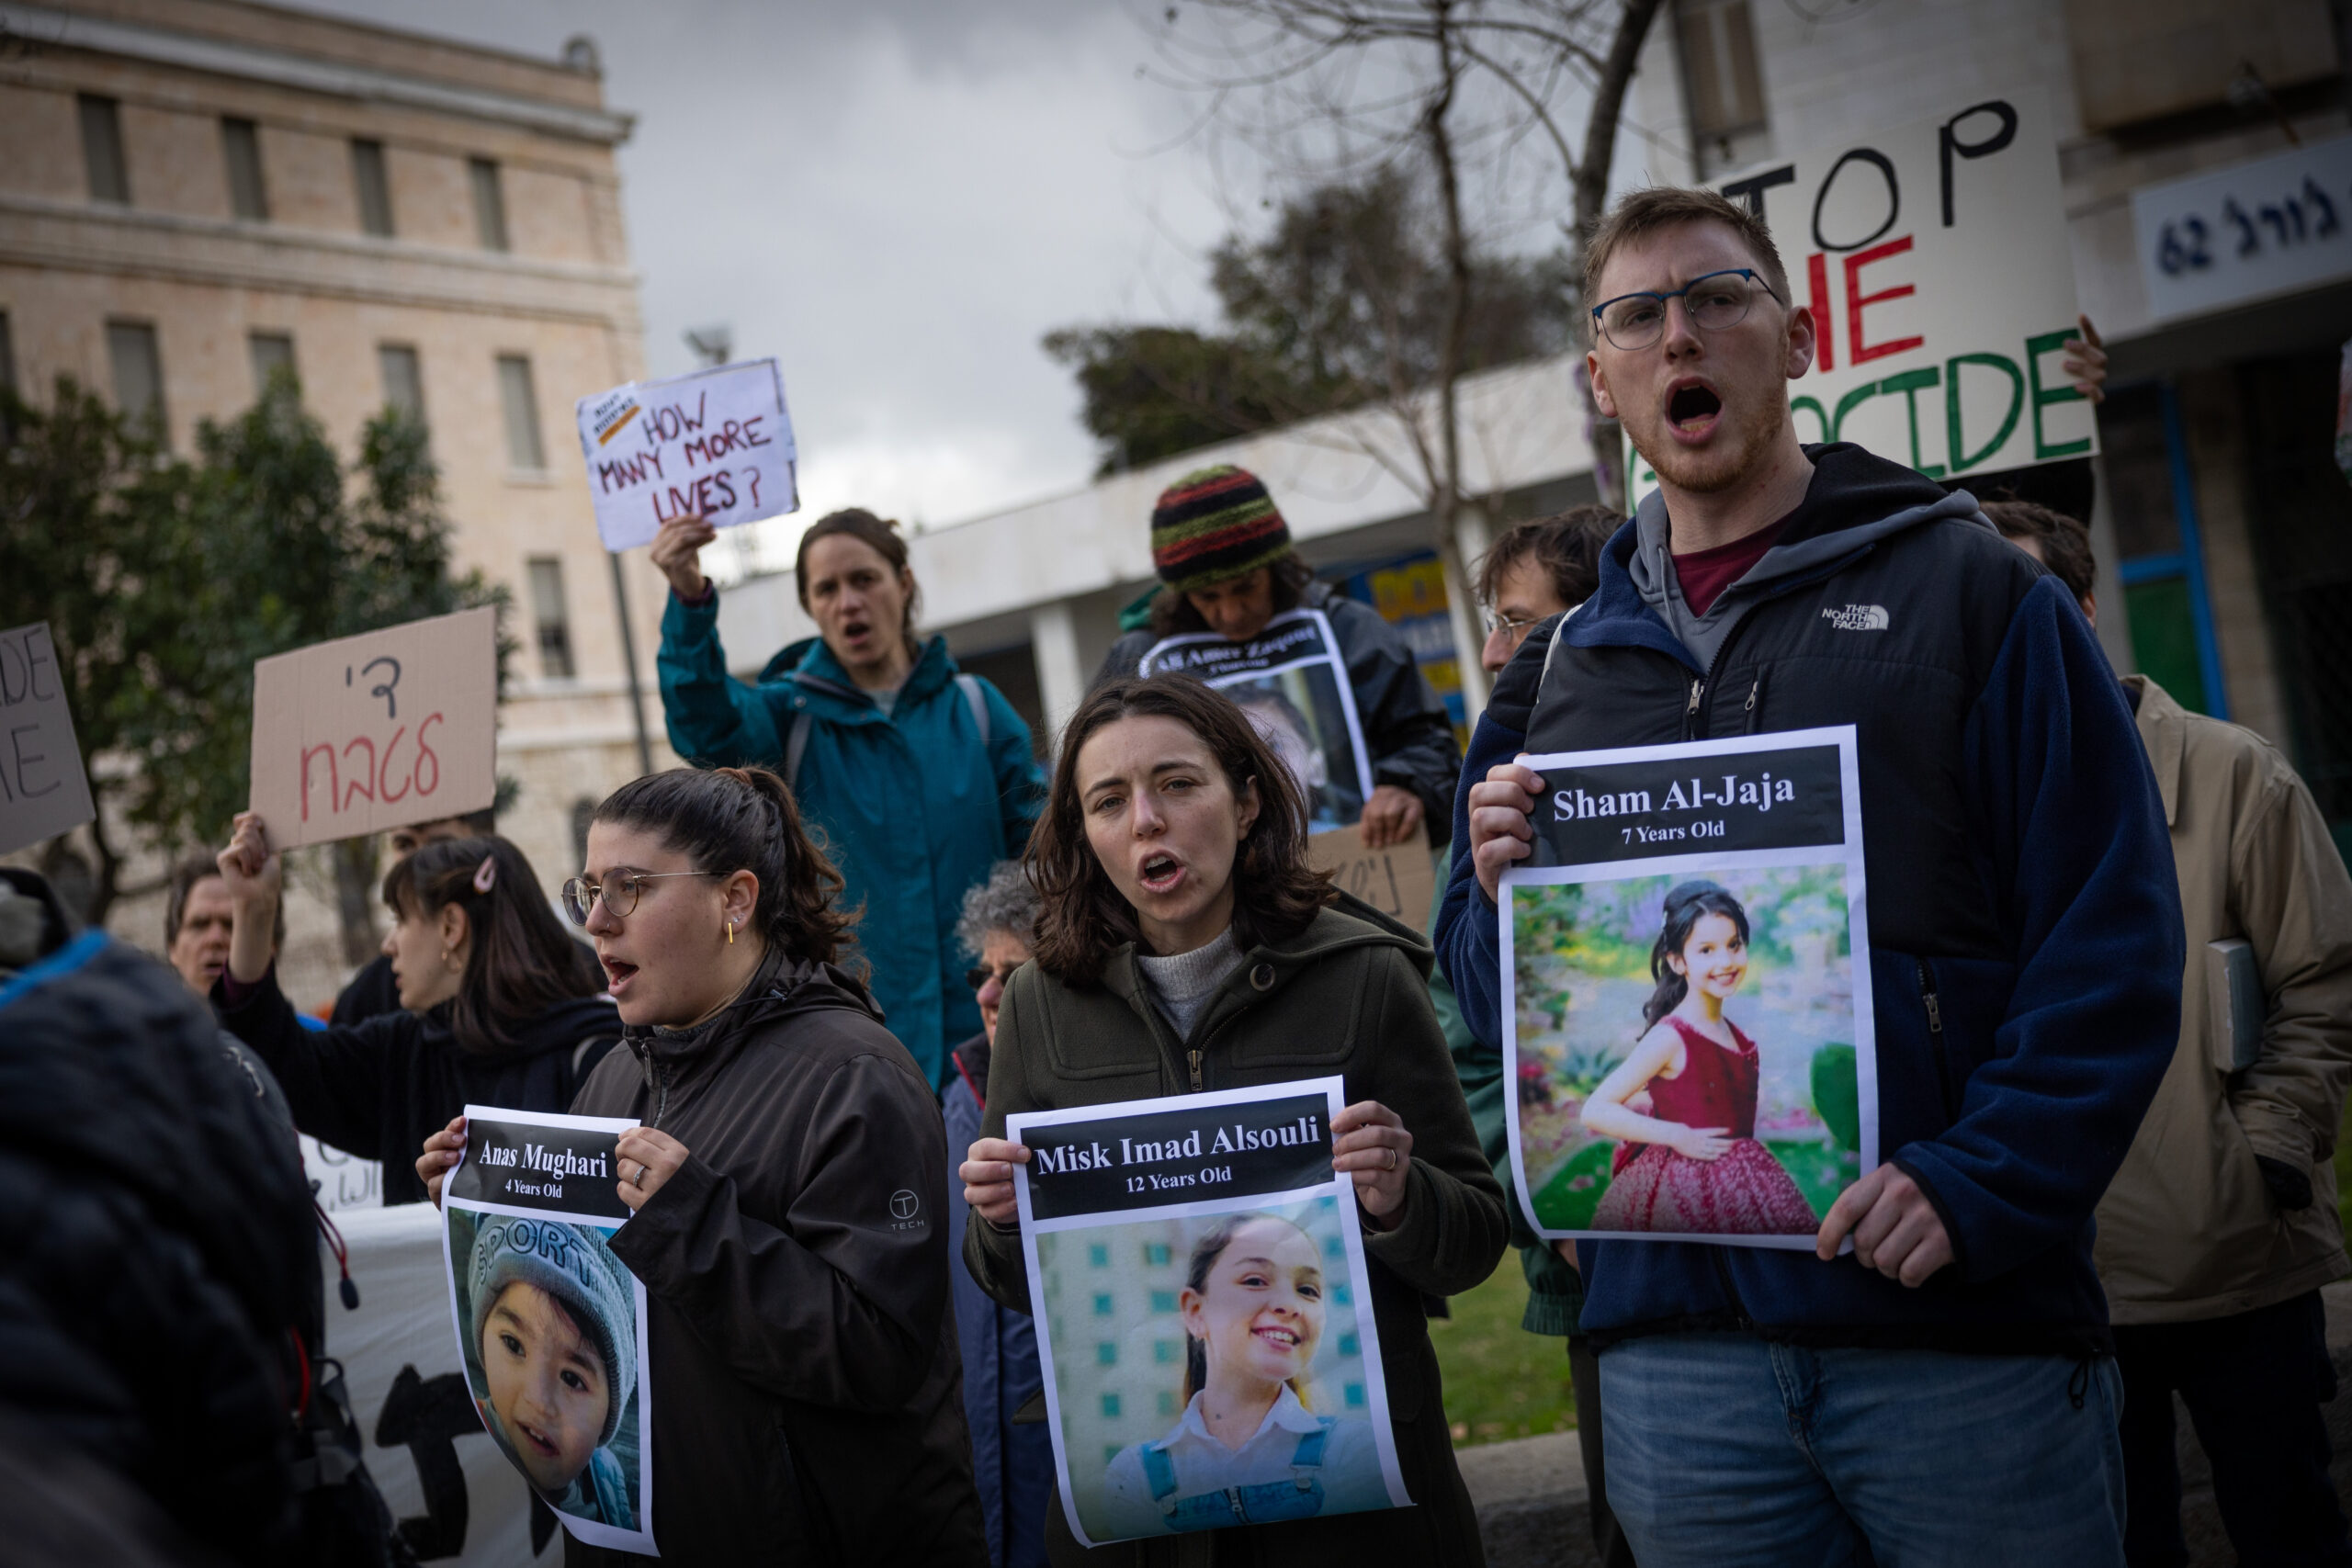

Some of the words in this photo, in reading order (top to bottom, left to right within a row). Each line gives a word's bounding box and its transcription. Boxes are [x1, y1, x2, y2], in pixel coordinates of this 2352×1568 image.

[1721, 99, 2018, 252] TOP
[642, 389, 707, 446] HOW
[597, 446, 663, 494] MANY
[684, 415, 772, 467] MORE
[1822, 608, 1868, 622] NORTH
[1832, 619, 1866, 630] FACE
[1845, 604, 1870, 614] THE
[345, 656, 402, 719] די
[300, 712, 444, 822] לטבח
[1554, 788, 1651, 822] Sham
[1660, 773, 1795, 812] Al-Jaja
[1622, 828, 1631, 844] 7
[1637, 824, 1686, 842] Years
[1690, 820, 1725, 838] Old
[479, 1139, 517, 1168] Anas
[521, 1143, 607, 1180] Mughari
[1035, 1142, 1113, 1175] Misk
[1119, 1131, 1202, 1166] Imad
[1210, 1115, 1320, 1154] Alsouli
[505, 1179, 512, 1192] 4
[514, 1179, 540, 1196] Years
[543, 1183, 562, 1199] Old
[1126, 1176, 1145, 1193] 12
[1148, 1173, 1195, 1191] Years
[1200, 1166, 1232, 1184] Old
[890, 1220, 924, 1231] TECH
[478, 1218, 595, 1287] SPORT
